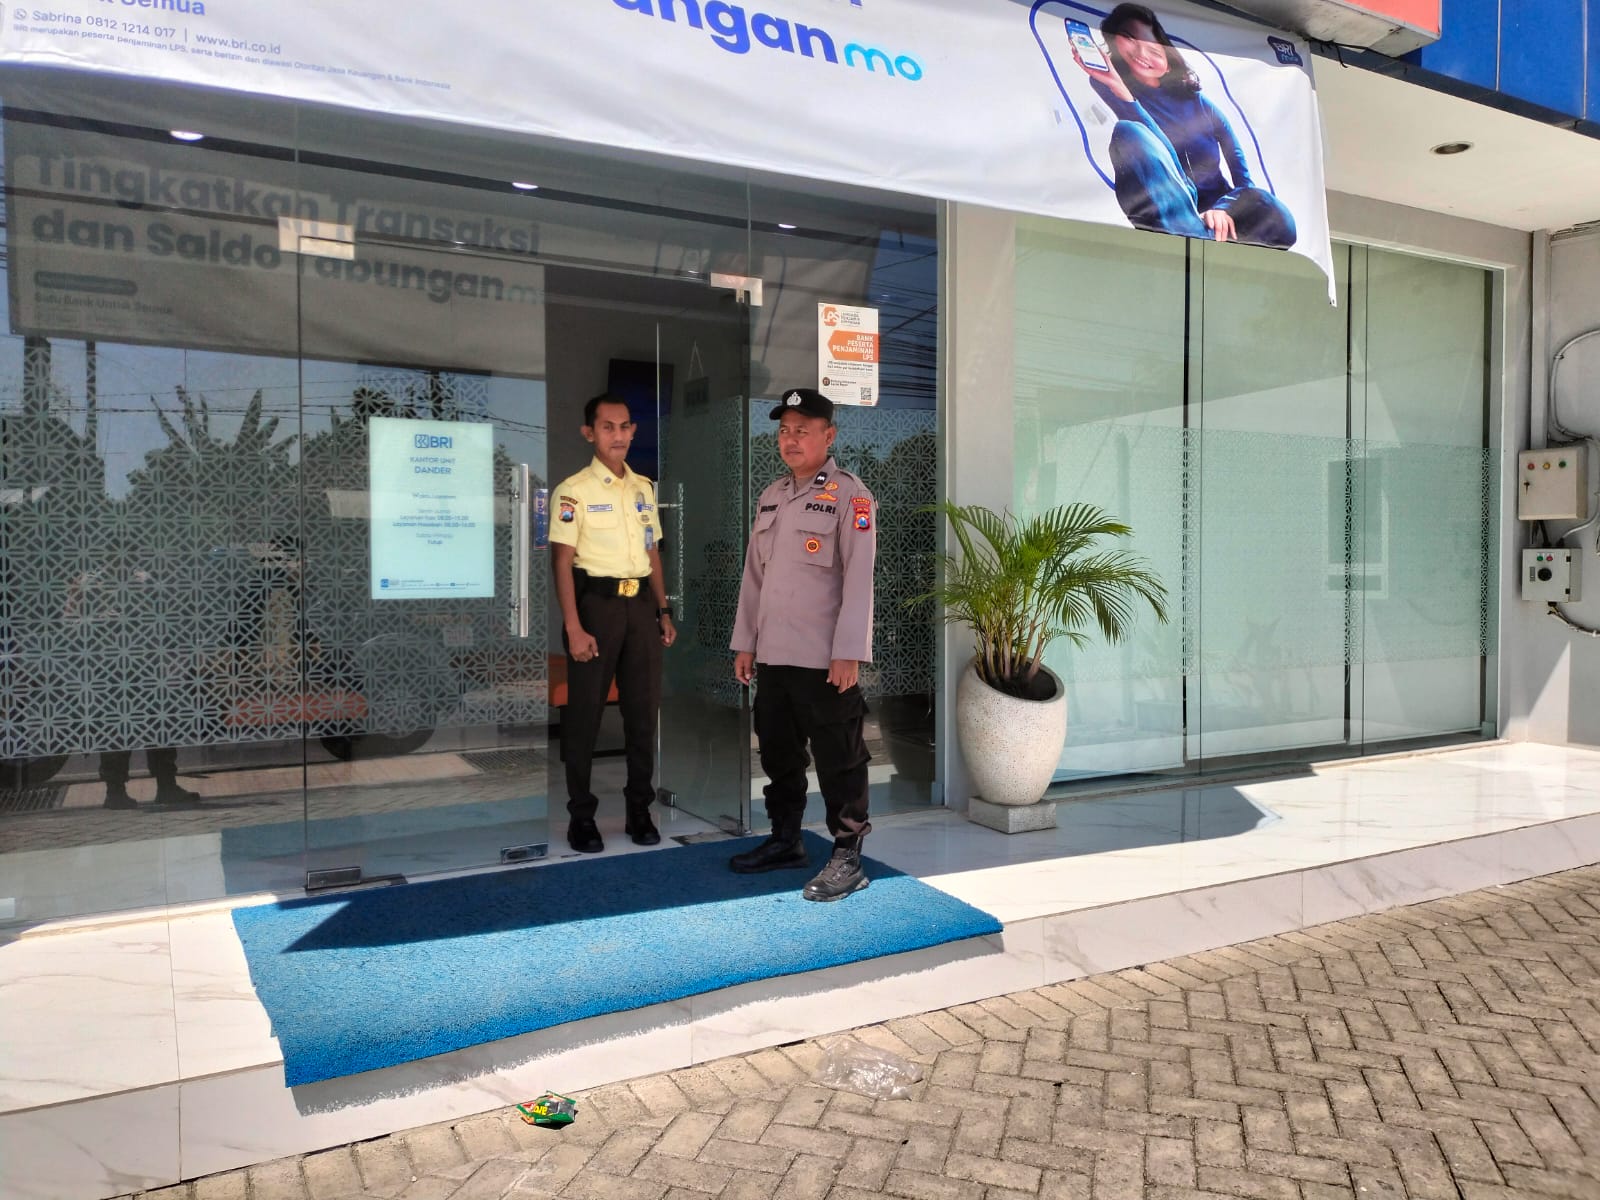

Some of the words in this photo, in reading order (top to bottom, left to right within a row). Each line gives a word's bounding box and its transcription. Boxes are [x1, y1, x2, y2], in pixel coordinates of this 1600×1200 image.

[33, 10, 82, 25] Sabrina
[86, 15, 118, 29] 0812
[122, 22, 150, 37] 1214
[154, 26, 176, 38] 017
[195, 33, 281, 55] www.bri.co.id
[81, 30, 115, 41] peserta
[36, 151, 319, 236] Tingkatkan
[329, 194, 540, 256] Transaksi
[32, 208, 136, 253] dan
[147, 221, 281, 270] Saldo
[430, 436, 453, 448] BRI
[415, 466, 452, 474] DANDER
[805, 502, 836, 514] POLRI
